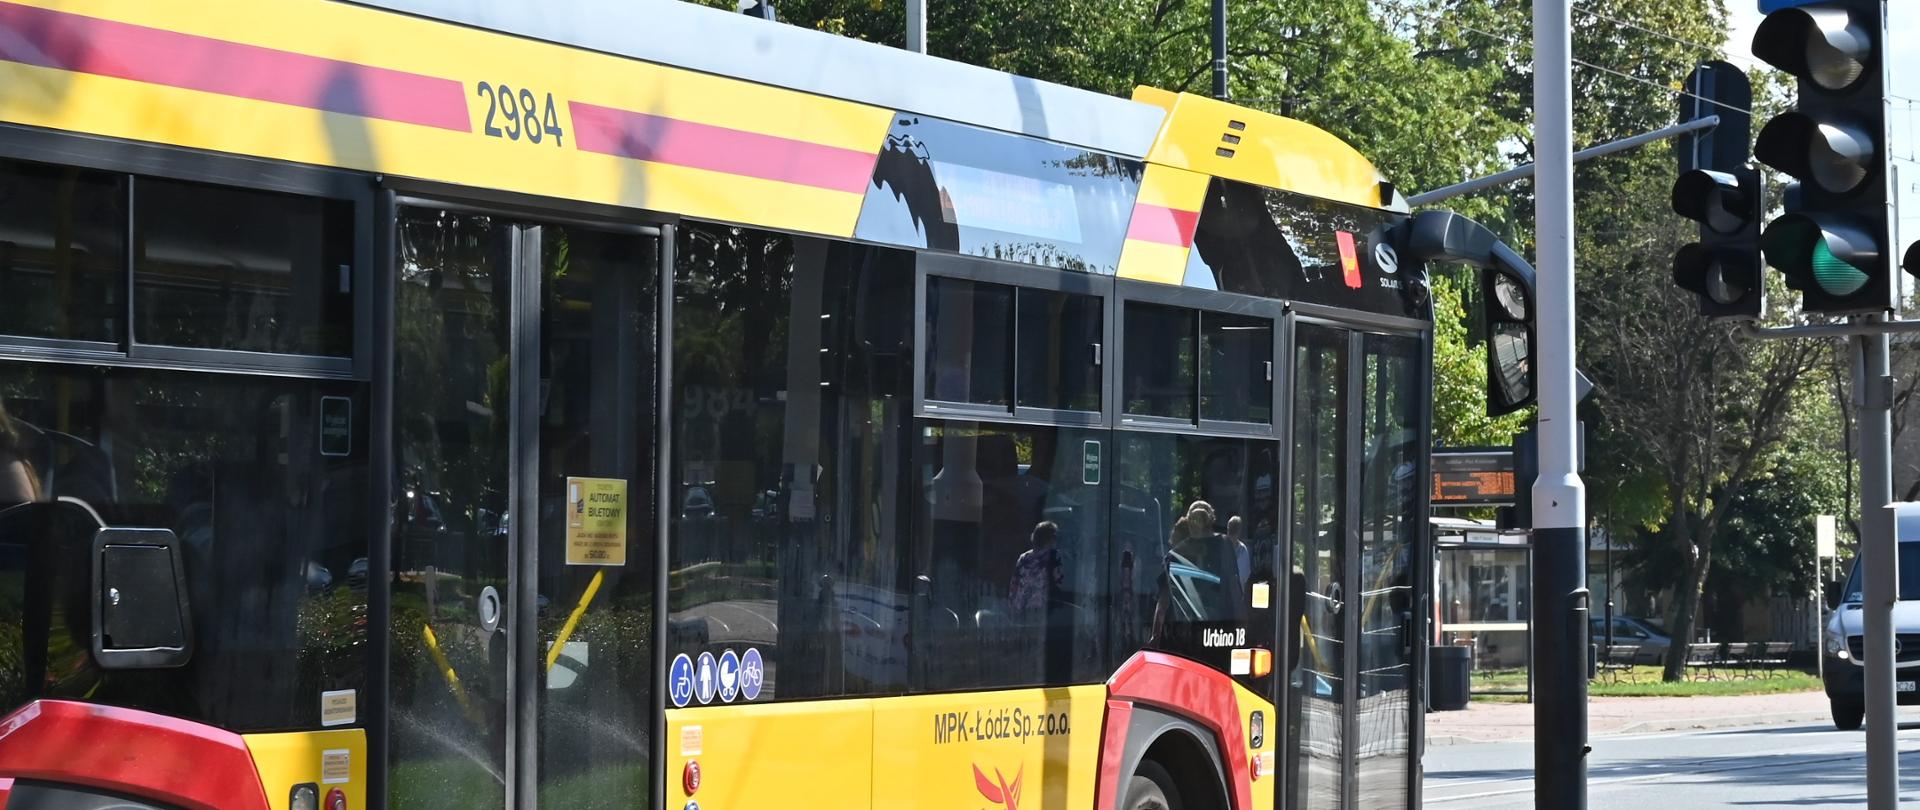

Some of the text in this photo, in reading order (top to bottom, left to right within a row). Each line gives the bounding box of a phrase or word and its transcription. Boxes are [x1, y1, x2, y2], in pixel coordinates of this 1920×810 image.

[477, 80, 562, 147] 2984
[589, 492, 620, 503] AUTOMAT
[588, 507, 621, 518] BILETOWY
[1203, 627, 1246, 647] Urbino 18
[934, 707, 1071, 745] MPK-Łódź Sp. z o.o.
